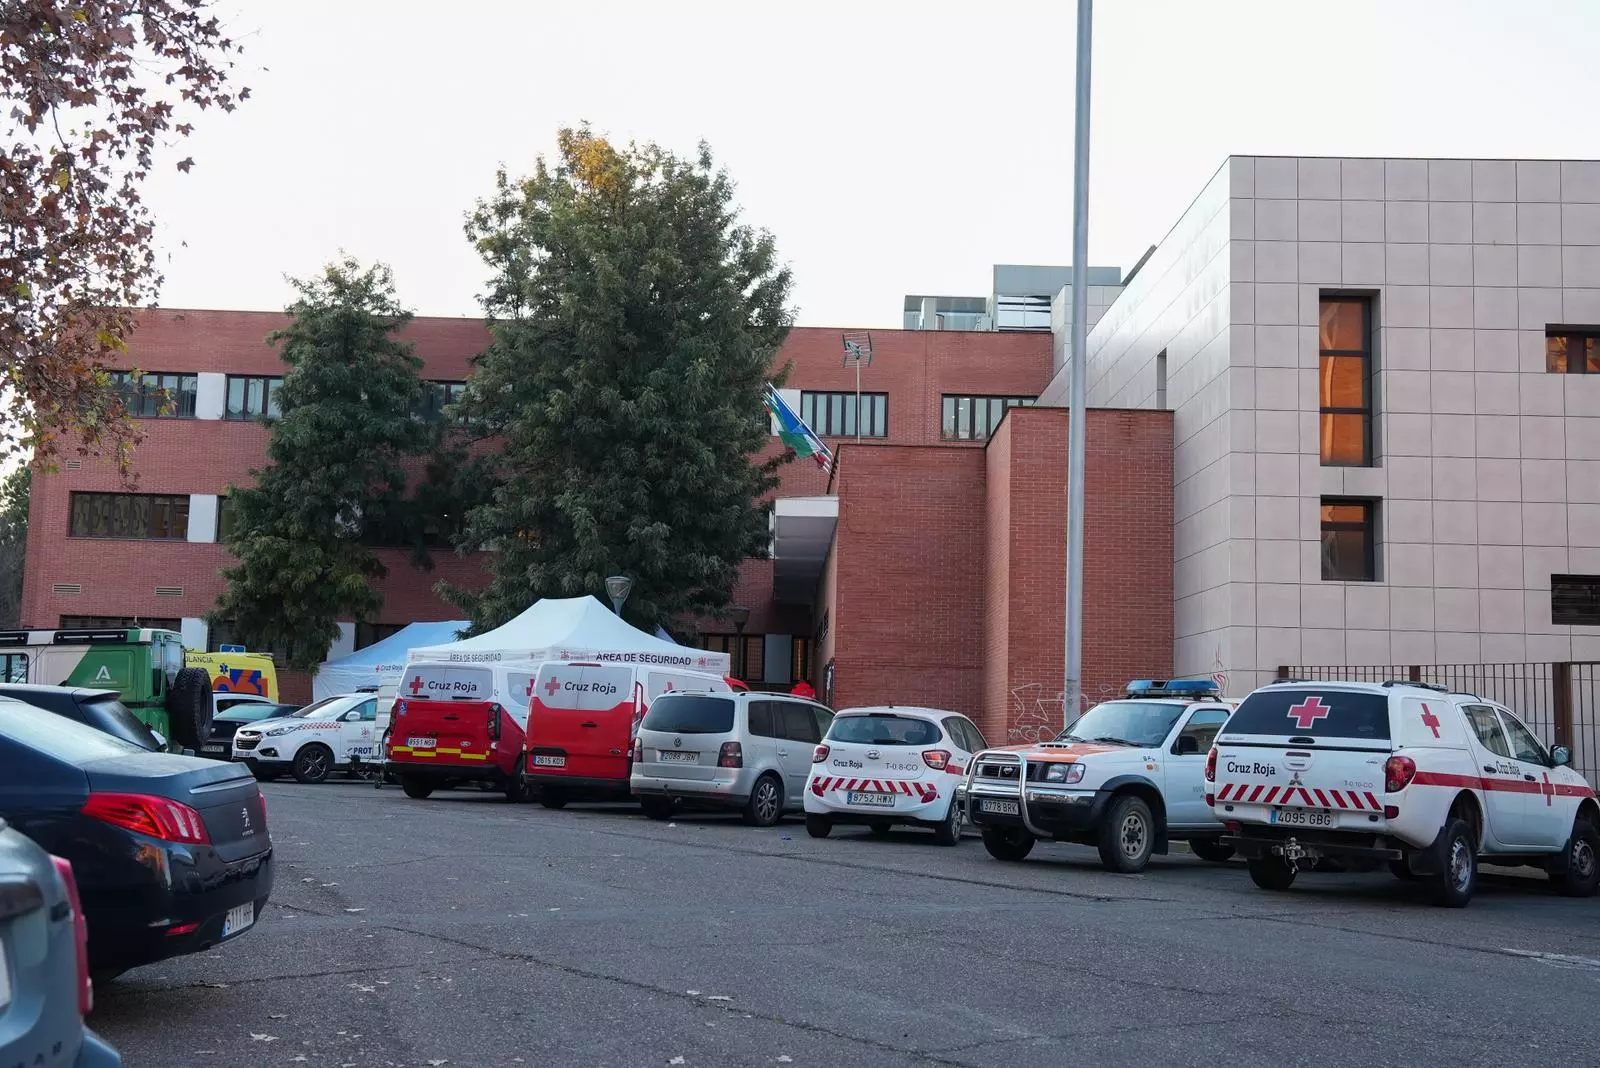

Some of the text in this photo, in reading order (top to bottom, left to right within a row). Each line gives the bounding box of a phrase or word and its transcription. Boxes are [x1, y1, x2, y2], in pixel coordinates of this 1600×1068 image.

[624, 653, 637, 662] DE
[638, 653, 692, 666] SEGURIDAD
[391, 665, 403, 673] Roja
[428, 681, 477, 693] Cruz Roja
[564, 681, 617, 695] Cruz Roja
[353, 747, 373, 755] PROT
[536, 756, 551, 765] 2615
[833, 760, 863, 770] Cruz Roja
[1227, 761, 1276, 777] Cruz Roja
[1495, 760, 1521, 779] Cruz Roja
[853, 793, 893, 804] 8752 HWX
[984, 800, 1017, 814] 3778 BRK
[1278, 811, 1331, 826] 4095 GBG
